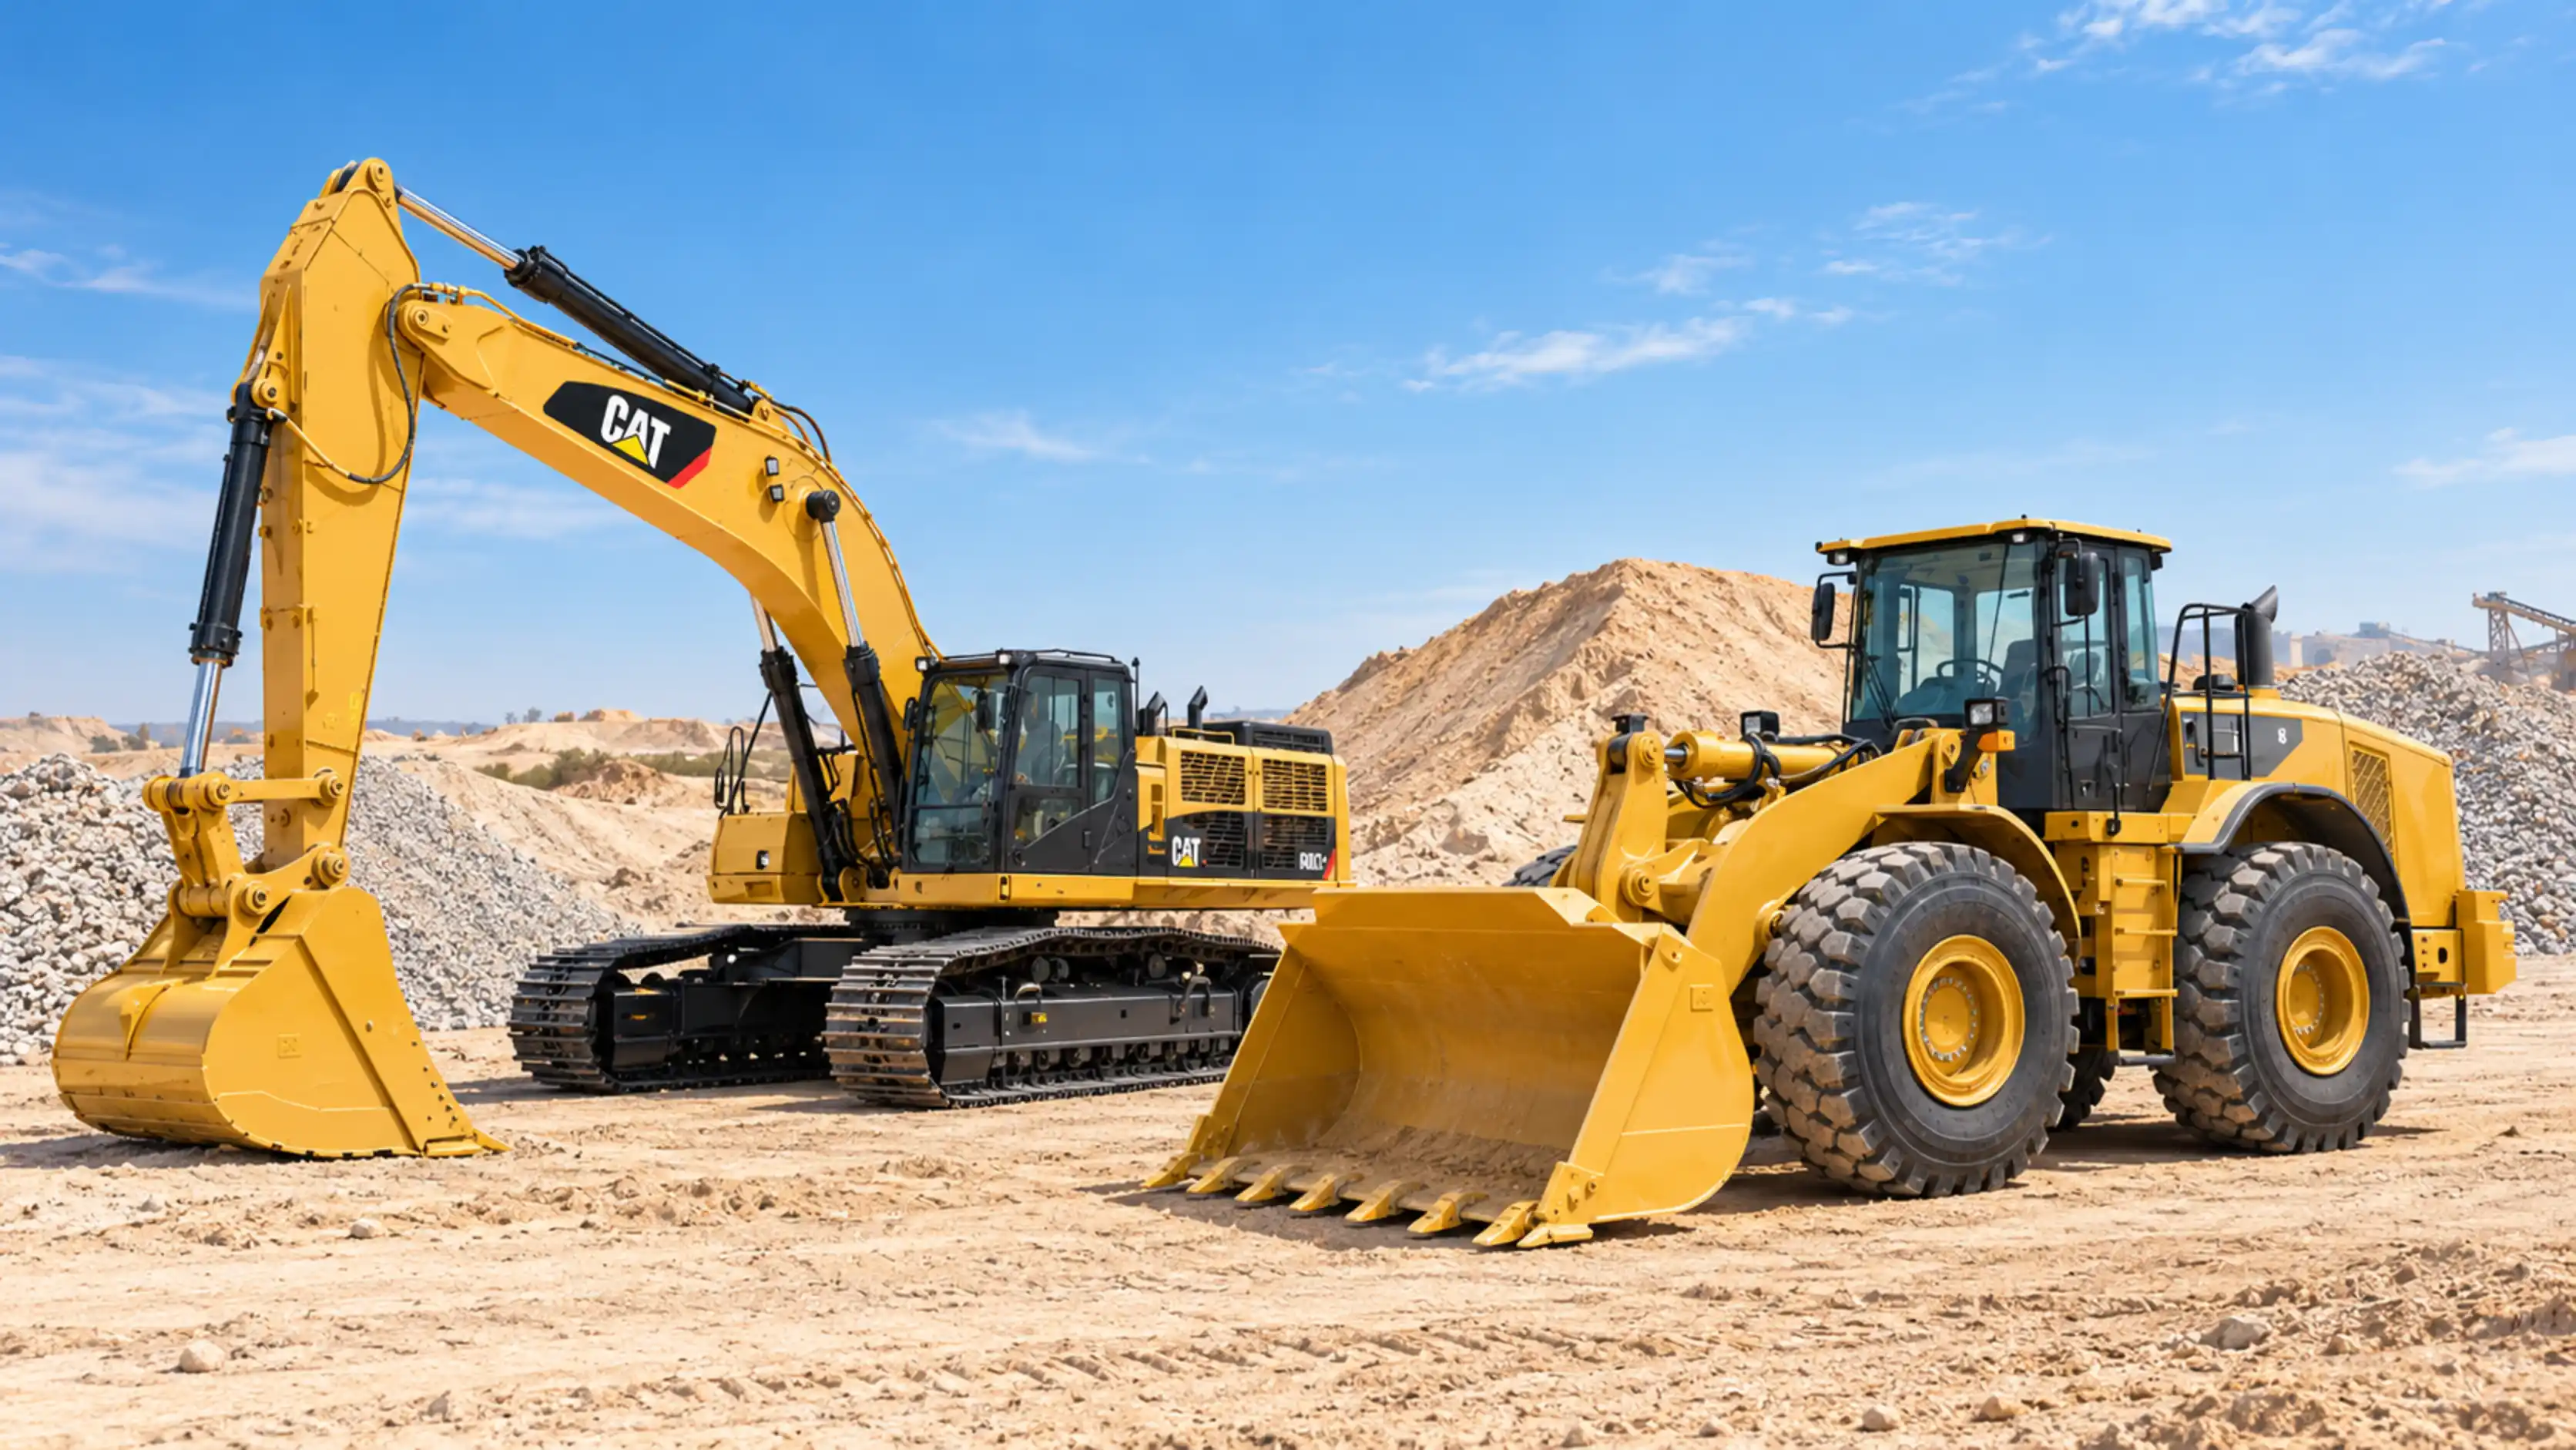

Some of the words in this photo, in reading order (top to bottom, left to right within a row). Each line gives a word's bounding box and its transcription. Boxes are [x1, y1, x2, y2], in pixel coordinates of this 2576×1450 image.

[600, 394, 672, 469] CAT
[2278, 727, 2287, 744] 8
[1172, 835, 1201, 867] CAT
